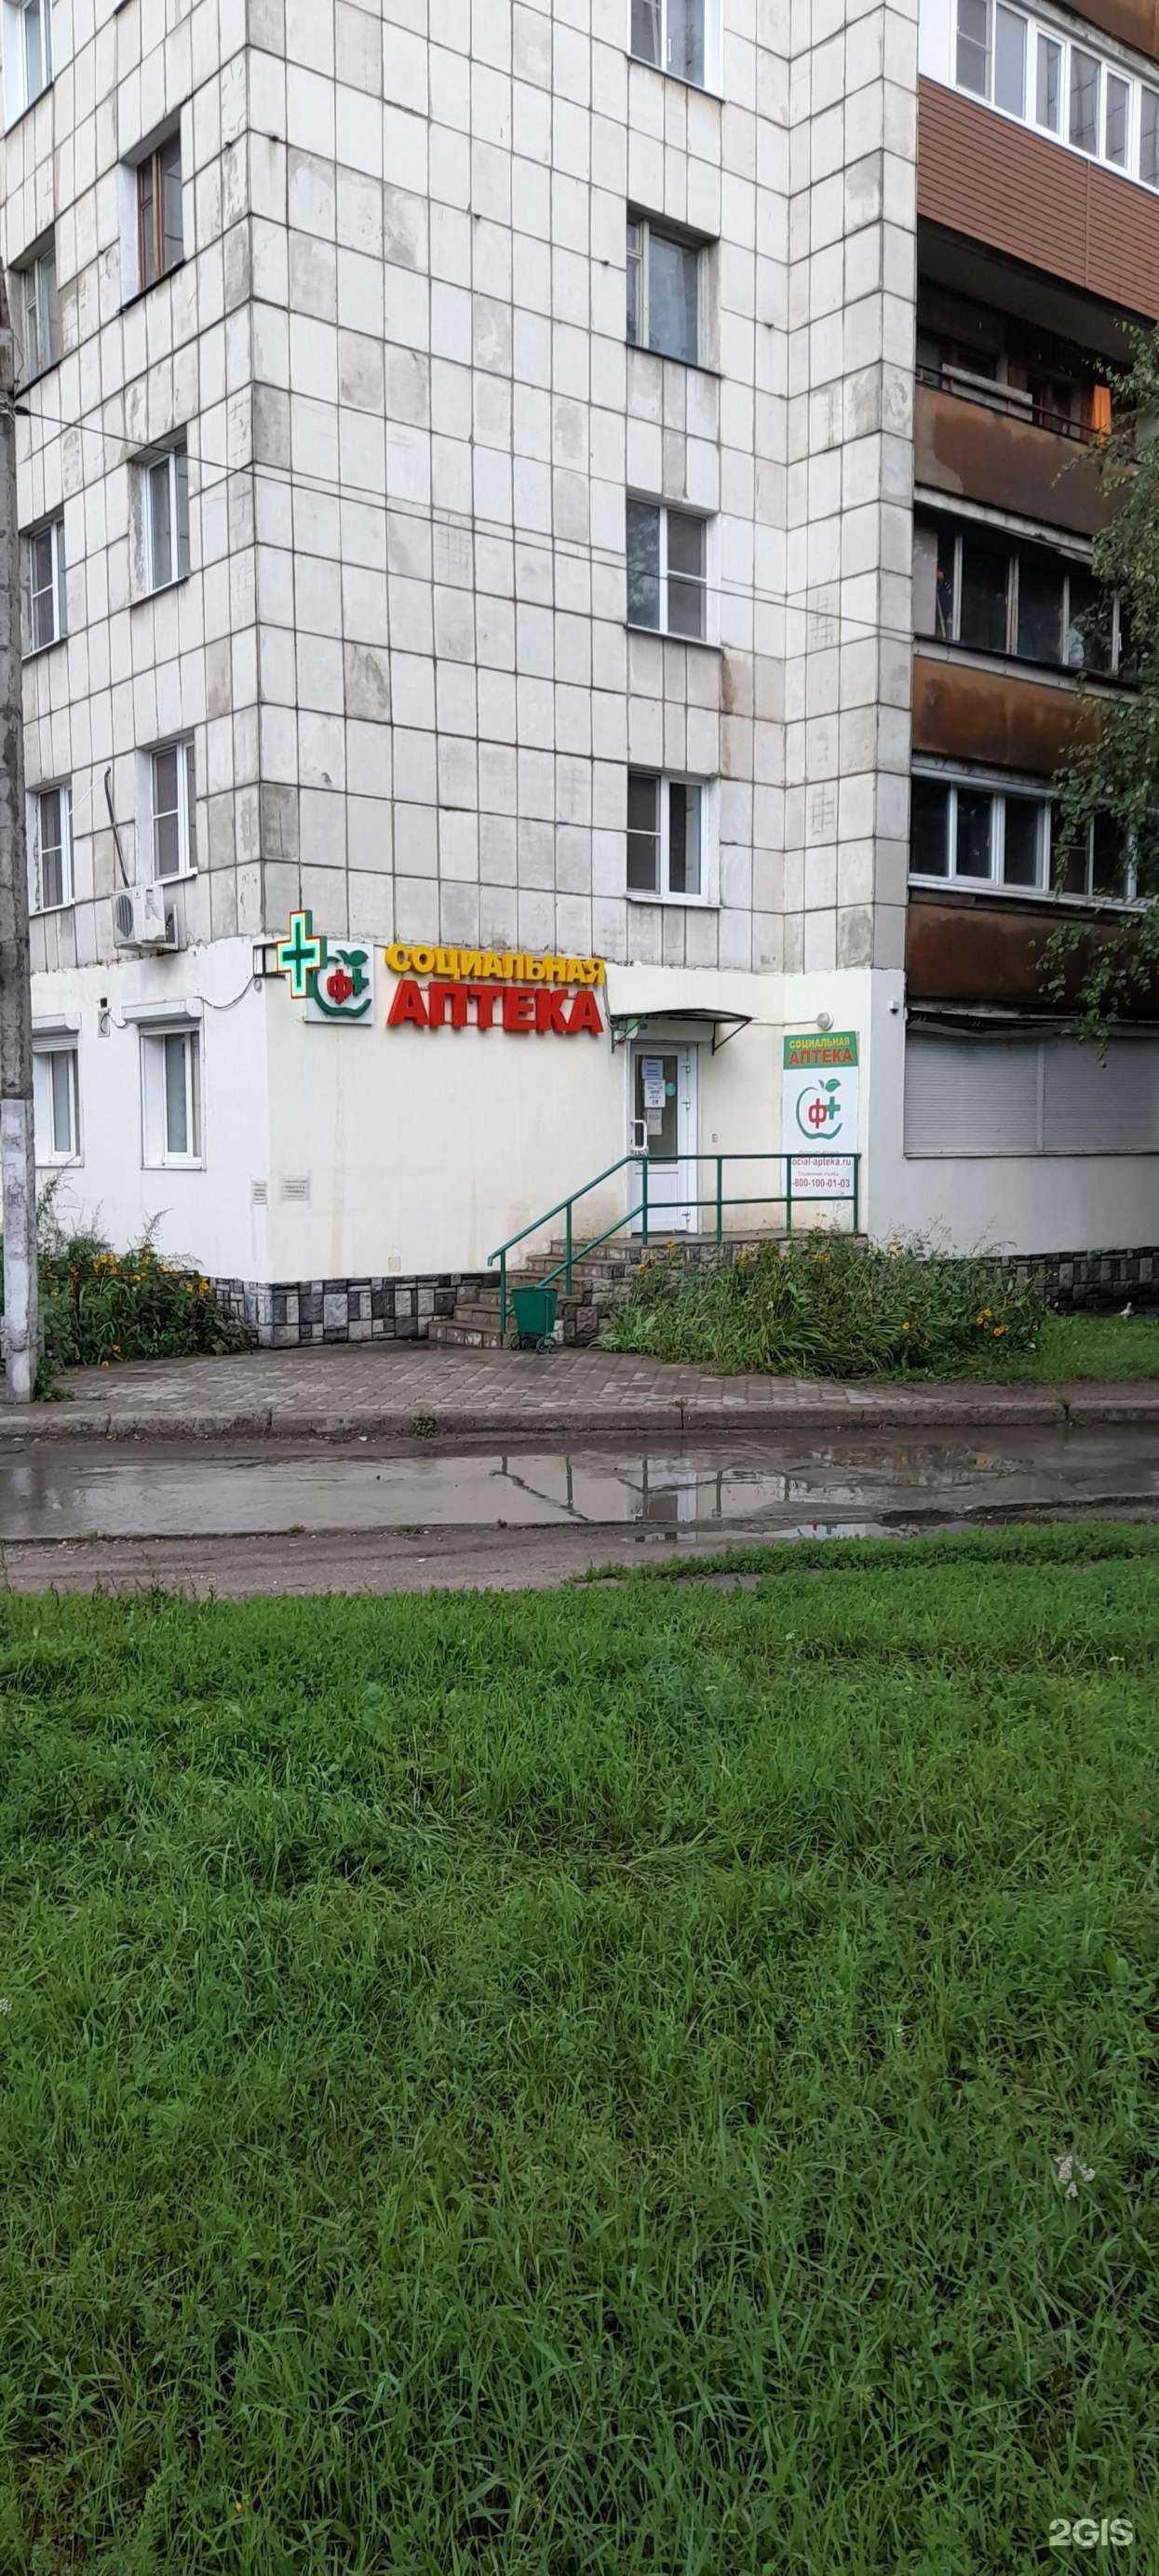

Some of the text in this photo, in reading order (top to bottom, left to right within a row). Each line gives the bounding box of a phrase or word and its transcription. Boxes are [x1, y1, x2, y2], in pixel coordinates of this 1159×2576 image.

[384, 944, 605, 985] СОЦИАЛЬНАЯ
[387, 980, 604, 1034] АПТЕКА
[789, 1037, 850, 1049] СОЦИАЛЬНАЯ
[789, 1048, 853, 1065] АПТЕКА
[791, 1157, 852, 1167] ocial-apteka.ru
[792, 1178, 851, 1188] -800-100-01-03
